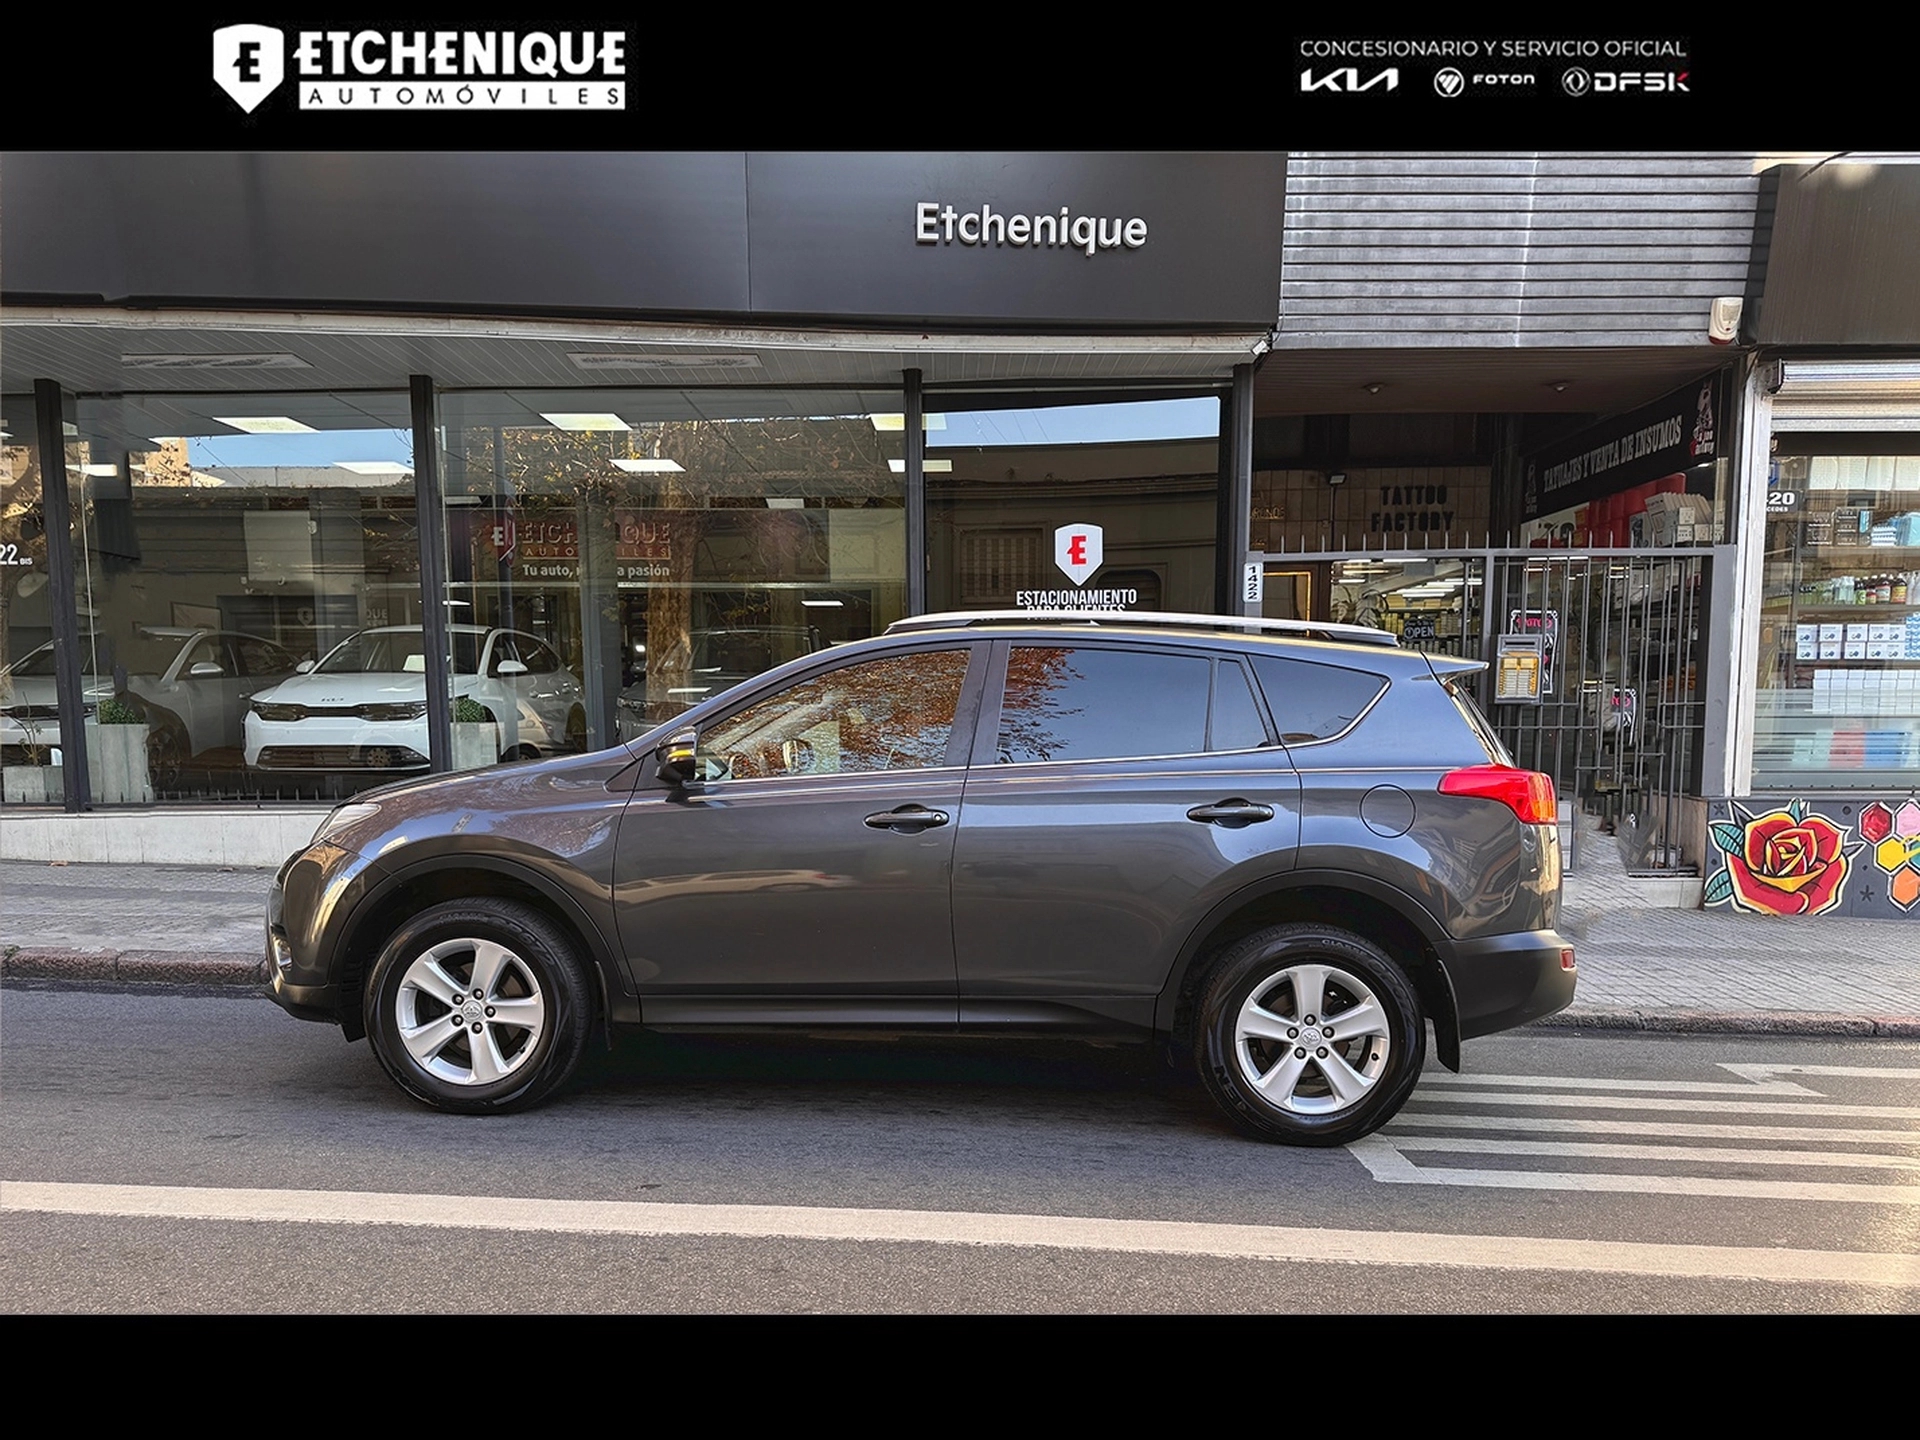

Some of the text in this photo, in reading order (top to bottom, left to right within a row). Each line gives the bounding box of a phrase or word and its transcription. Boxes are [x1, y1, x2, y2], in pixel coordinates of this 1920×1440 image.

[916, 202, 1148, 257] Etchenique
[1582, 452, 1590, 478] Y
[1620, 433, 1634, 464] DE
[1634, 414, 1682, 459] INSUMOS
[1380, 485, 1447, 506] TATTOO
[1766, 491, 1796, 505] 20
[1371, 511, 1454, 532] FACTORY
[522, 564, 538, 577] Tu
[540, 564, 574, 578] auto,
[627, 563, 670, 579] pasión
[1248, 565, 1258, 600] 1422
[1016, 588, 1138, 606] ESTACIONAMIENTO
[1404, 626, 1434, 640] OPEN
